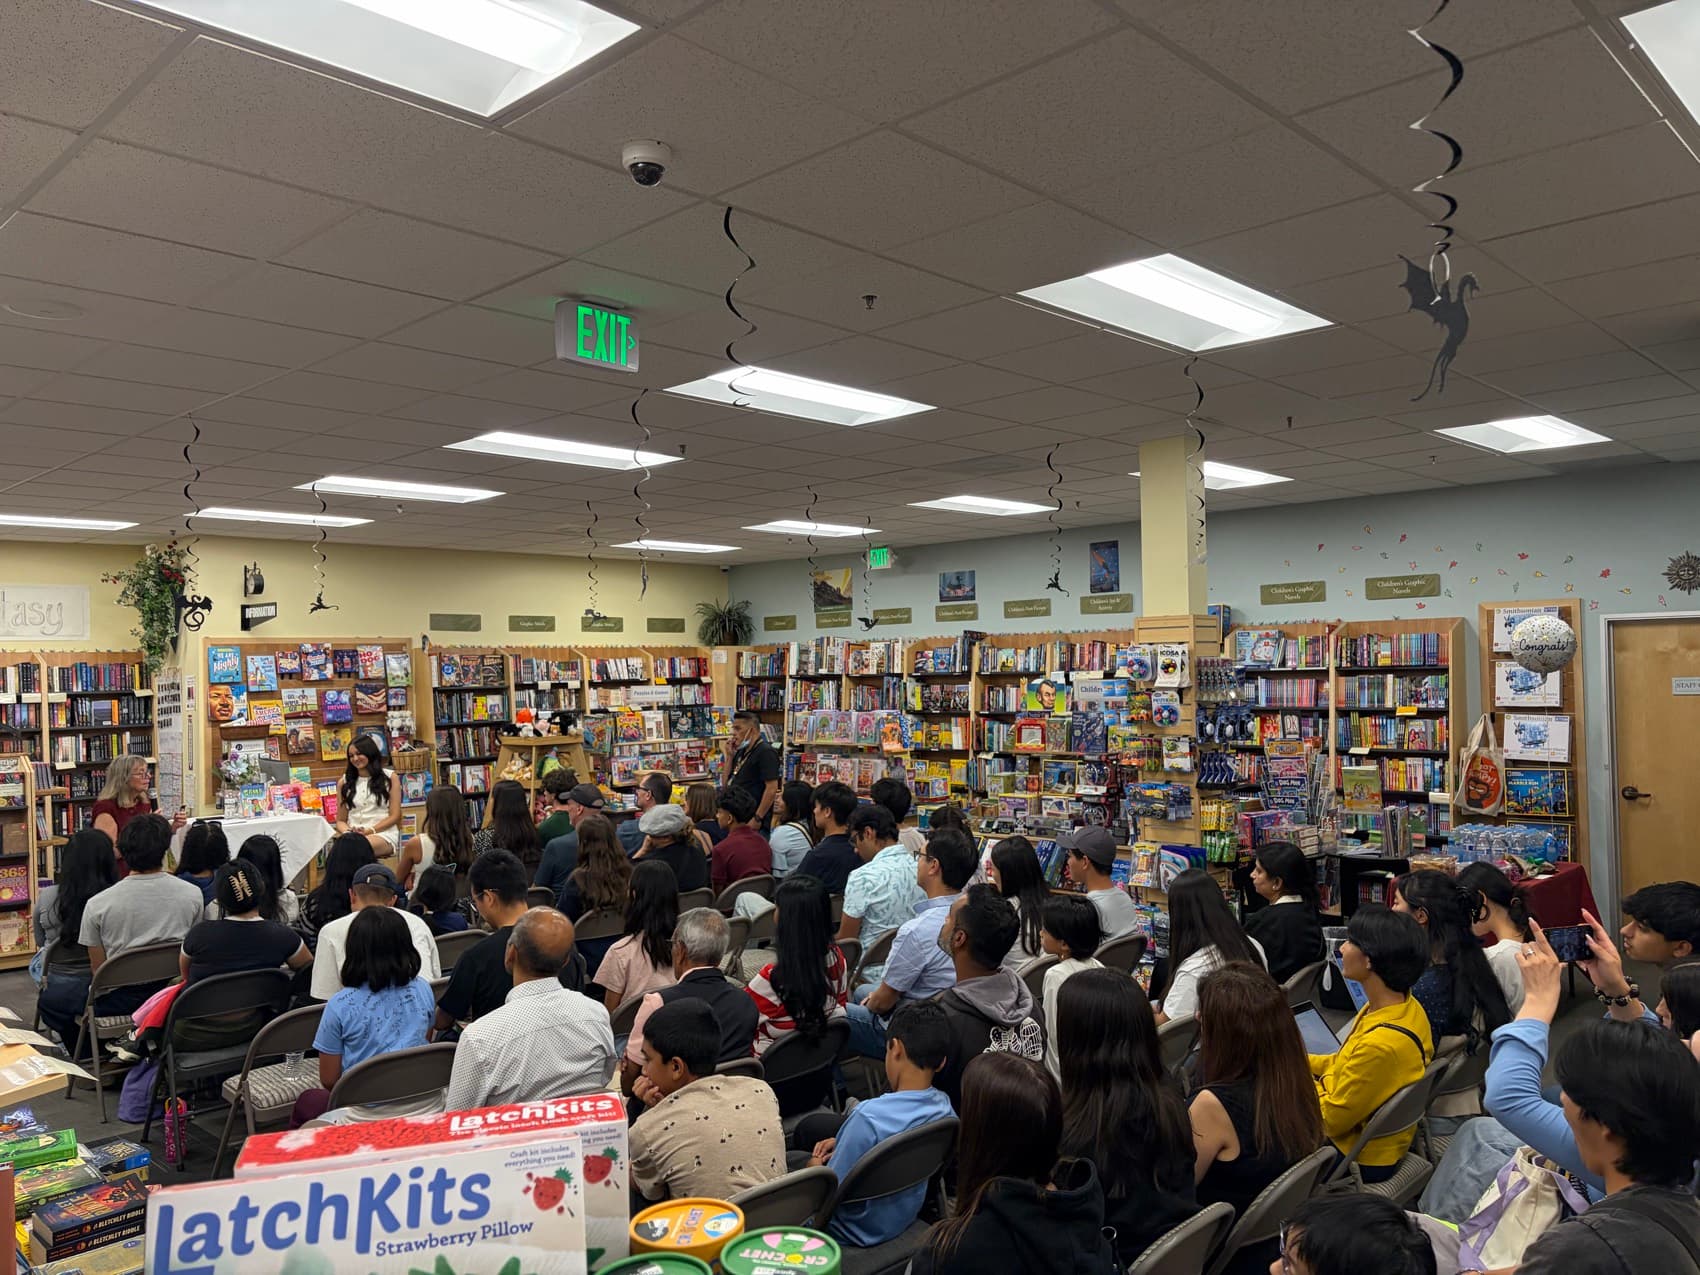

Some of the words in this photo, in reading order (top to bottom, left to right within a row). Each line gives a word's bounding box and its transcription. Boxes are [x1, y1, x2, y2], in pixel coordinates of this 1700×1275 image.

[577, 305, 631, 367] EXIT
[870, 548, 888, 568] EXIT
[1404, 578, 1426, 587] Graphic
[246, 605, 276, 618] INFORMATION
[1519, 638, 1569, 656] Congrats!
[449, 1099, 614, 1132] LatchKits
[504, 1157, 541, 1168] everything
[542, 1155, 555, 1163] you
[510, 1149, 529, 1159] Craft
[529, 1147, 539, 1156] kit
[541, 1145, 570, 1155] includes
[98, 1214, 127, 1228] BLETCHLEY
[126, 1208, 145, 1219] RIDDLE
[153, 1165, 492, 1275] LatchKits
[93, 1231, 122, 1245] BLETCHLEY
[121, 1225, 140, 1236] RIDDLE
[375, 1228, 477, 1257] Strawberry
[481, 1219, 534, 1241] Pillow
